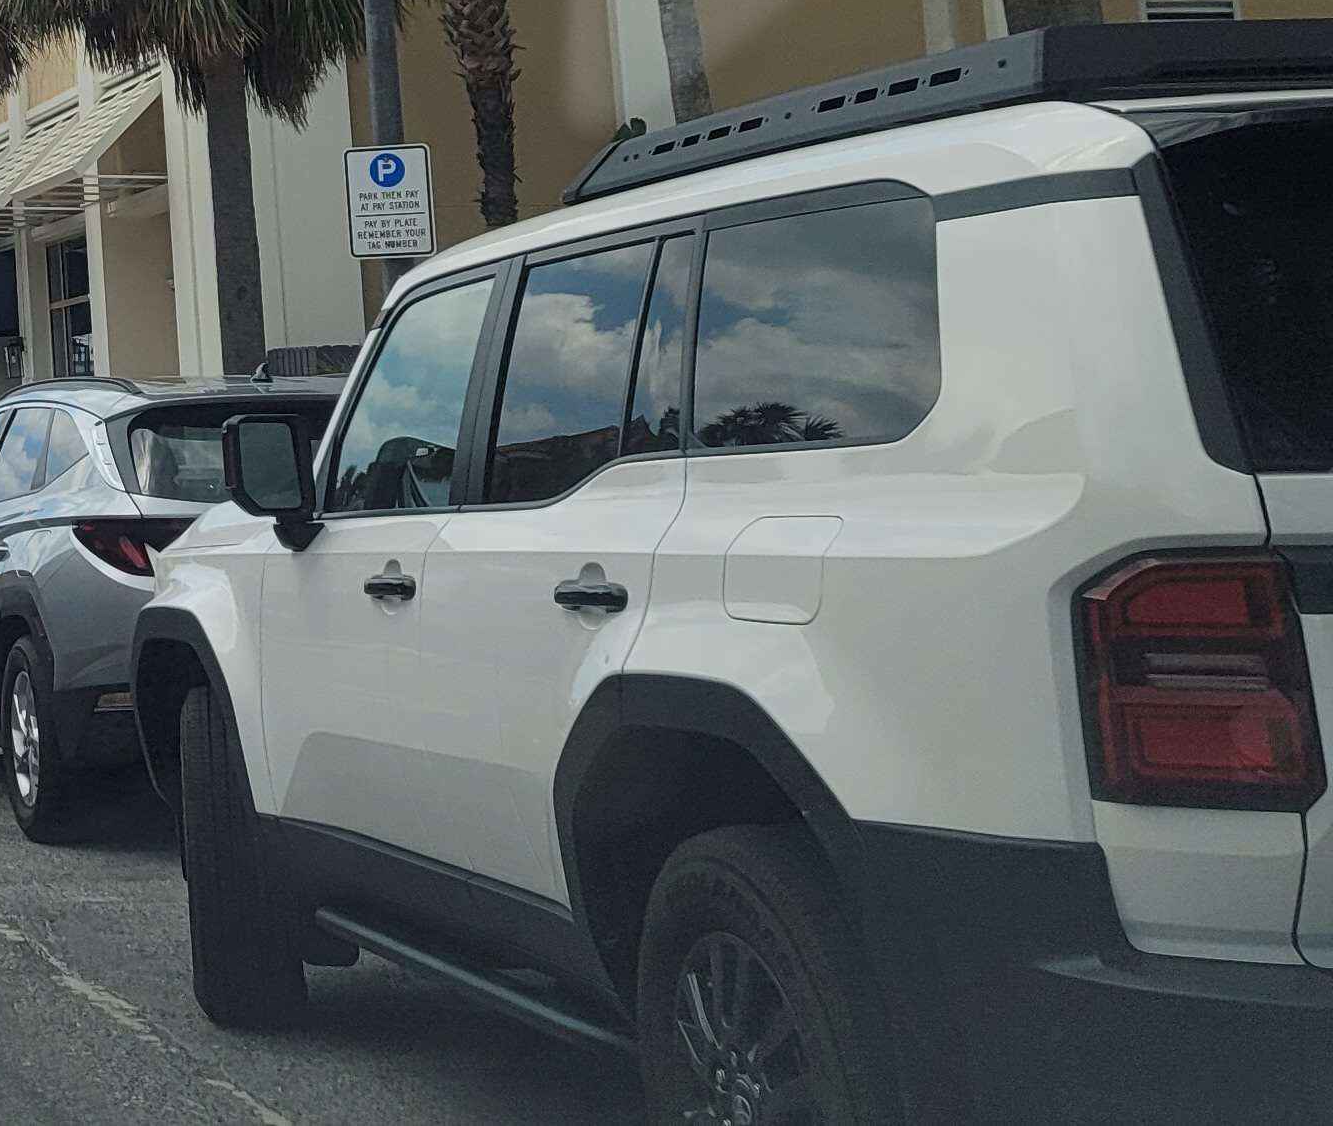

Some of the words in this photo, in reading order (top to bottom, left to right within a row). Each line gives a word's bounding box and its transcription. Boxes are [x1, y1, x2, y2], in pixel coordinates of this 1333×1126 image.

[377, 159, 396, 182] P
[359, 192, 378, 201] PARK
[381, 191, 402, 199] THEN
[406, 190, 420, 198] PAY
[360, 203, 369, 211] AT
[373, 202, 385, 210] PAY
[389, 201, 420, 209] STATION
[364, 220, 377, 228] PAY
[381, 219, 391, 227] BY
[394, 218, 418, 226] PLATE
[357, 230, 402, 239] REMEMBER
[405, 228, 426, 237] YOUR
[367, 241, 381, 249] TAG
[384, 240, 418, 248] NUMBER
